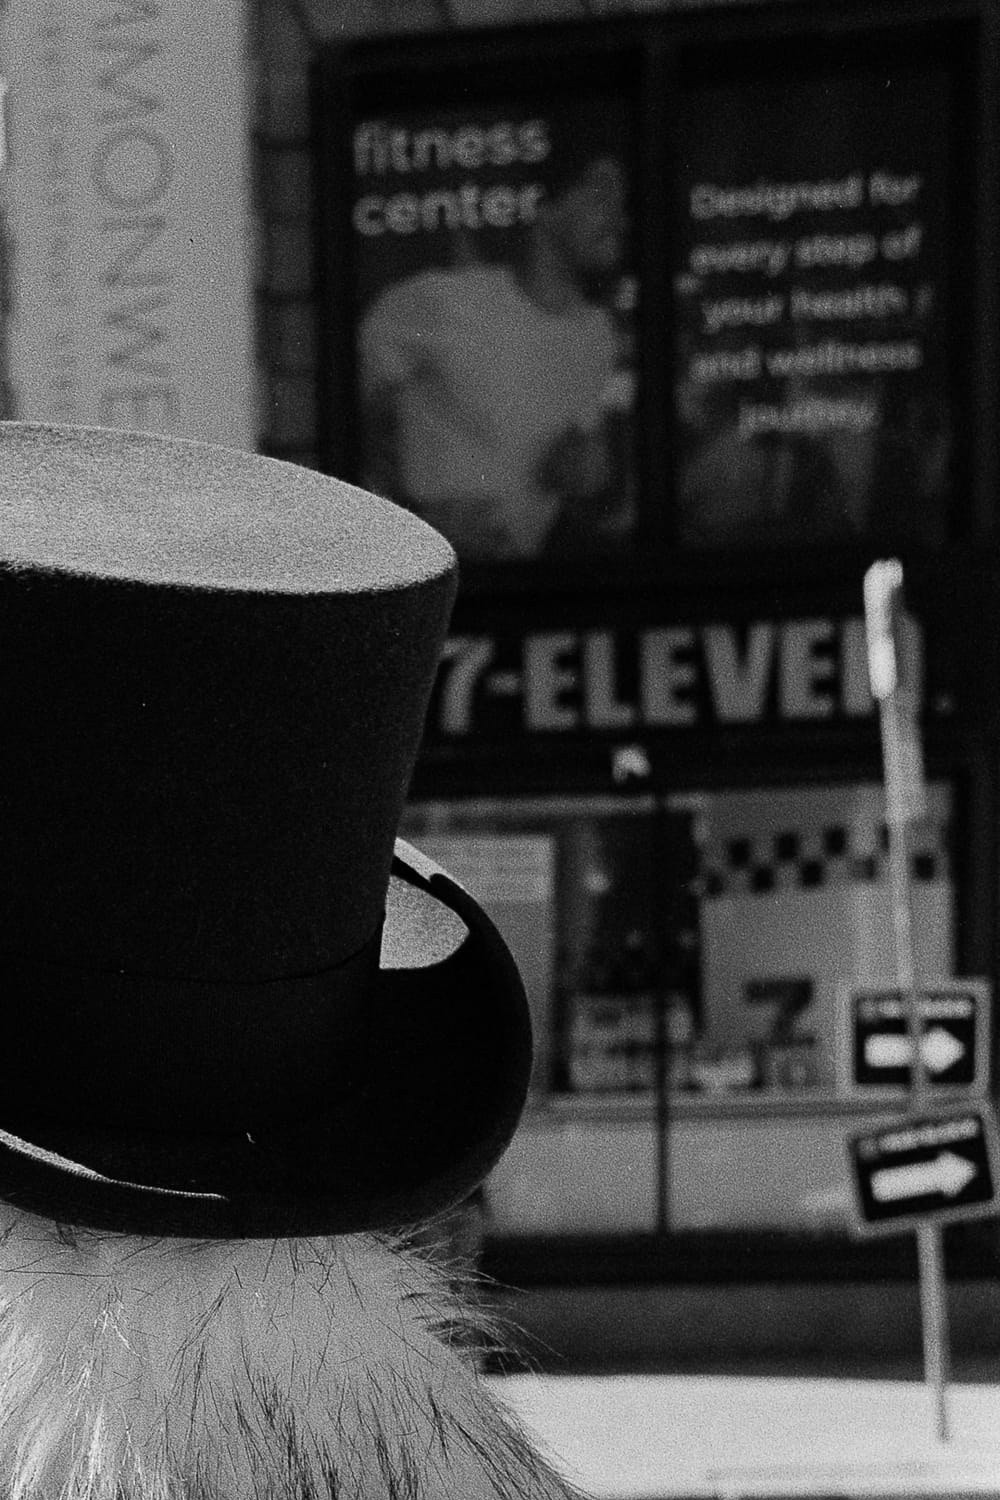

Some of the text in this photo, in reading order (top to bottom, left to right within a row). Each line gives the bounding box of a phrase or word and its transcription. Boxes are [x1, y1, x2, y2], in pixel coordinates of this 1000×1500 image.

[355, 123, 548, 173] fitness
[355, 185, 541, 234] center
[692, 174, 919, 217] Designed for
[692, 227, 921, 274] every step of
[704, 288, 905, 331] your health
[692, 342, 919, 380] and wellness
